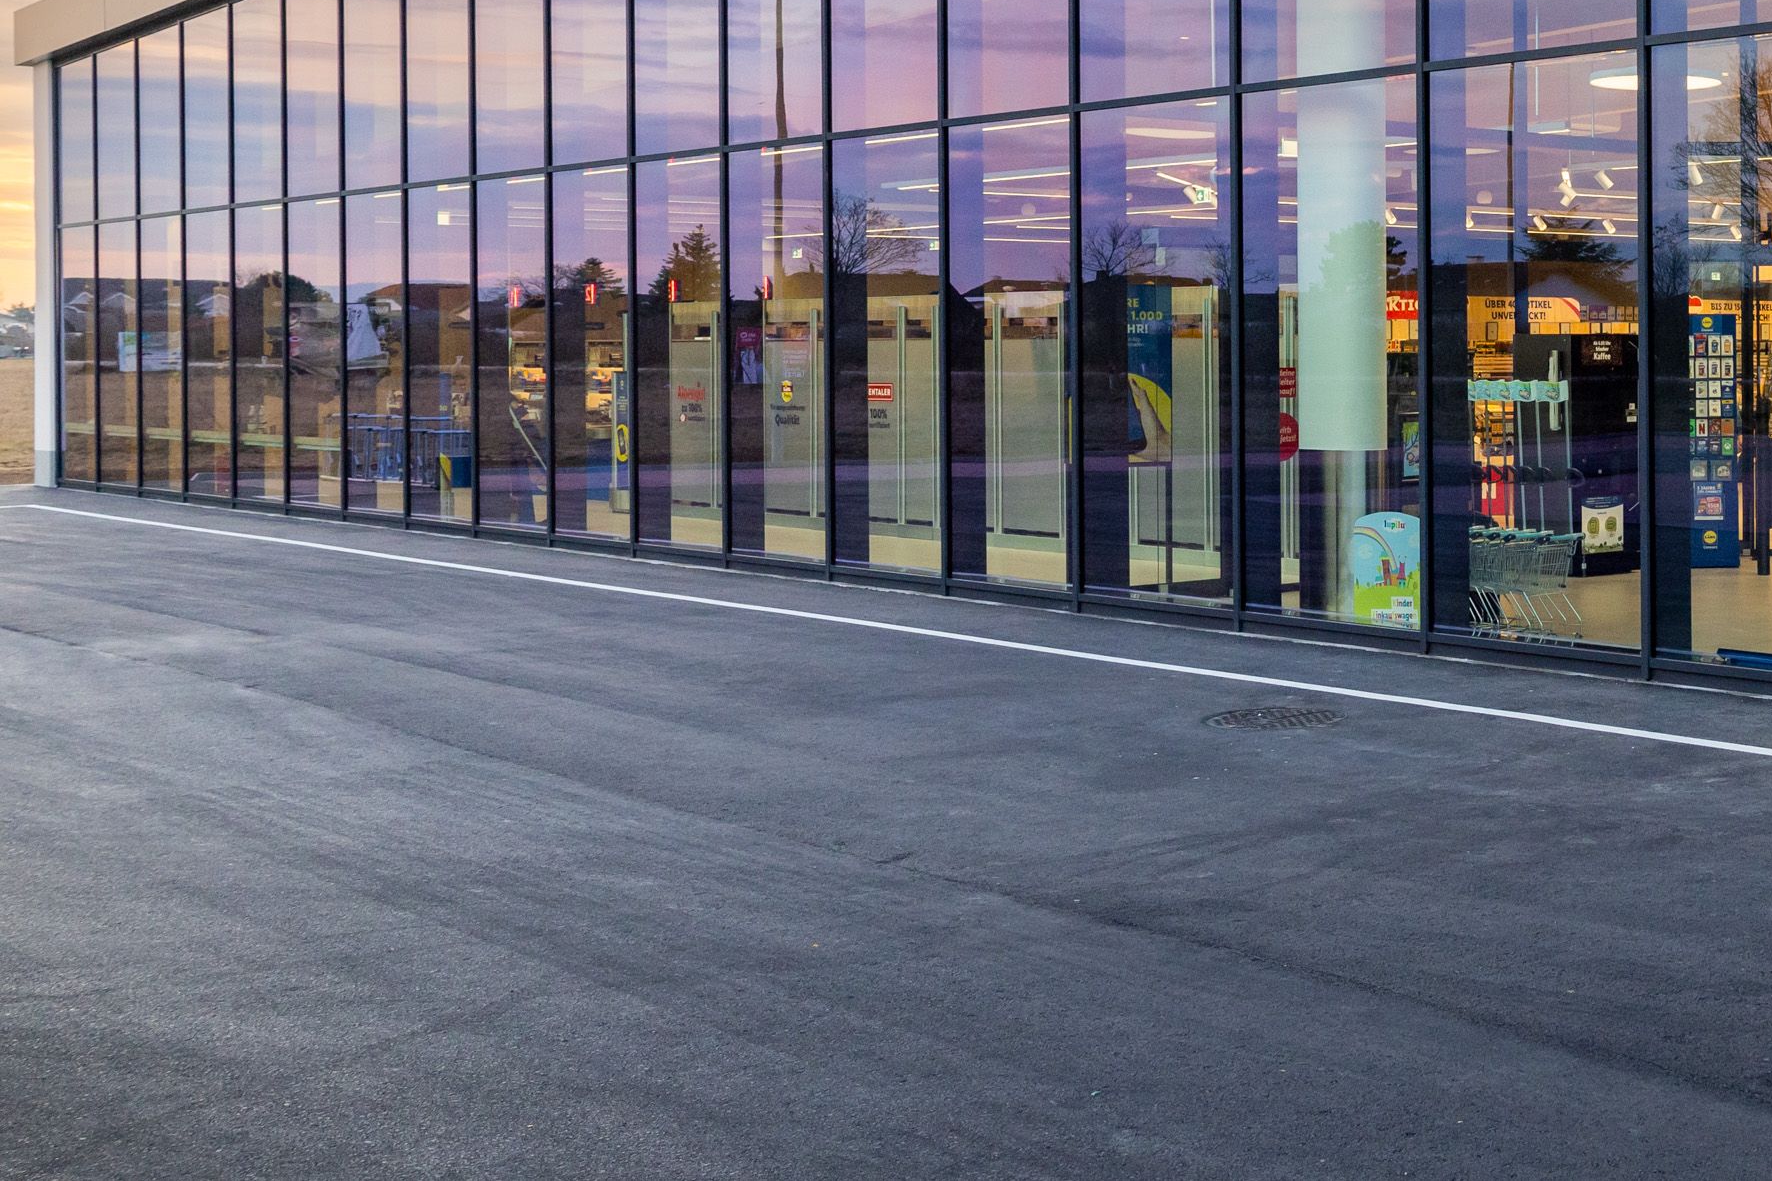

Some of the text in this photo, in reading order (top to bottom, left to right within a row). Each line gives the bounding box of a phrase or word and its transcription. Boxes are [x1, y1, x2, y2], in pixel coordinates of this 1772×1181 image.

[1485, 298, 1506, 308] ÜBER
[1711, 303, 1722, 311] BIS
[1724, 303, 1732, 311] ZU
[1127, 324, 1149, 333] HR!
